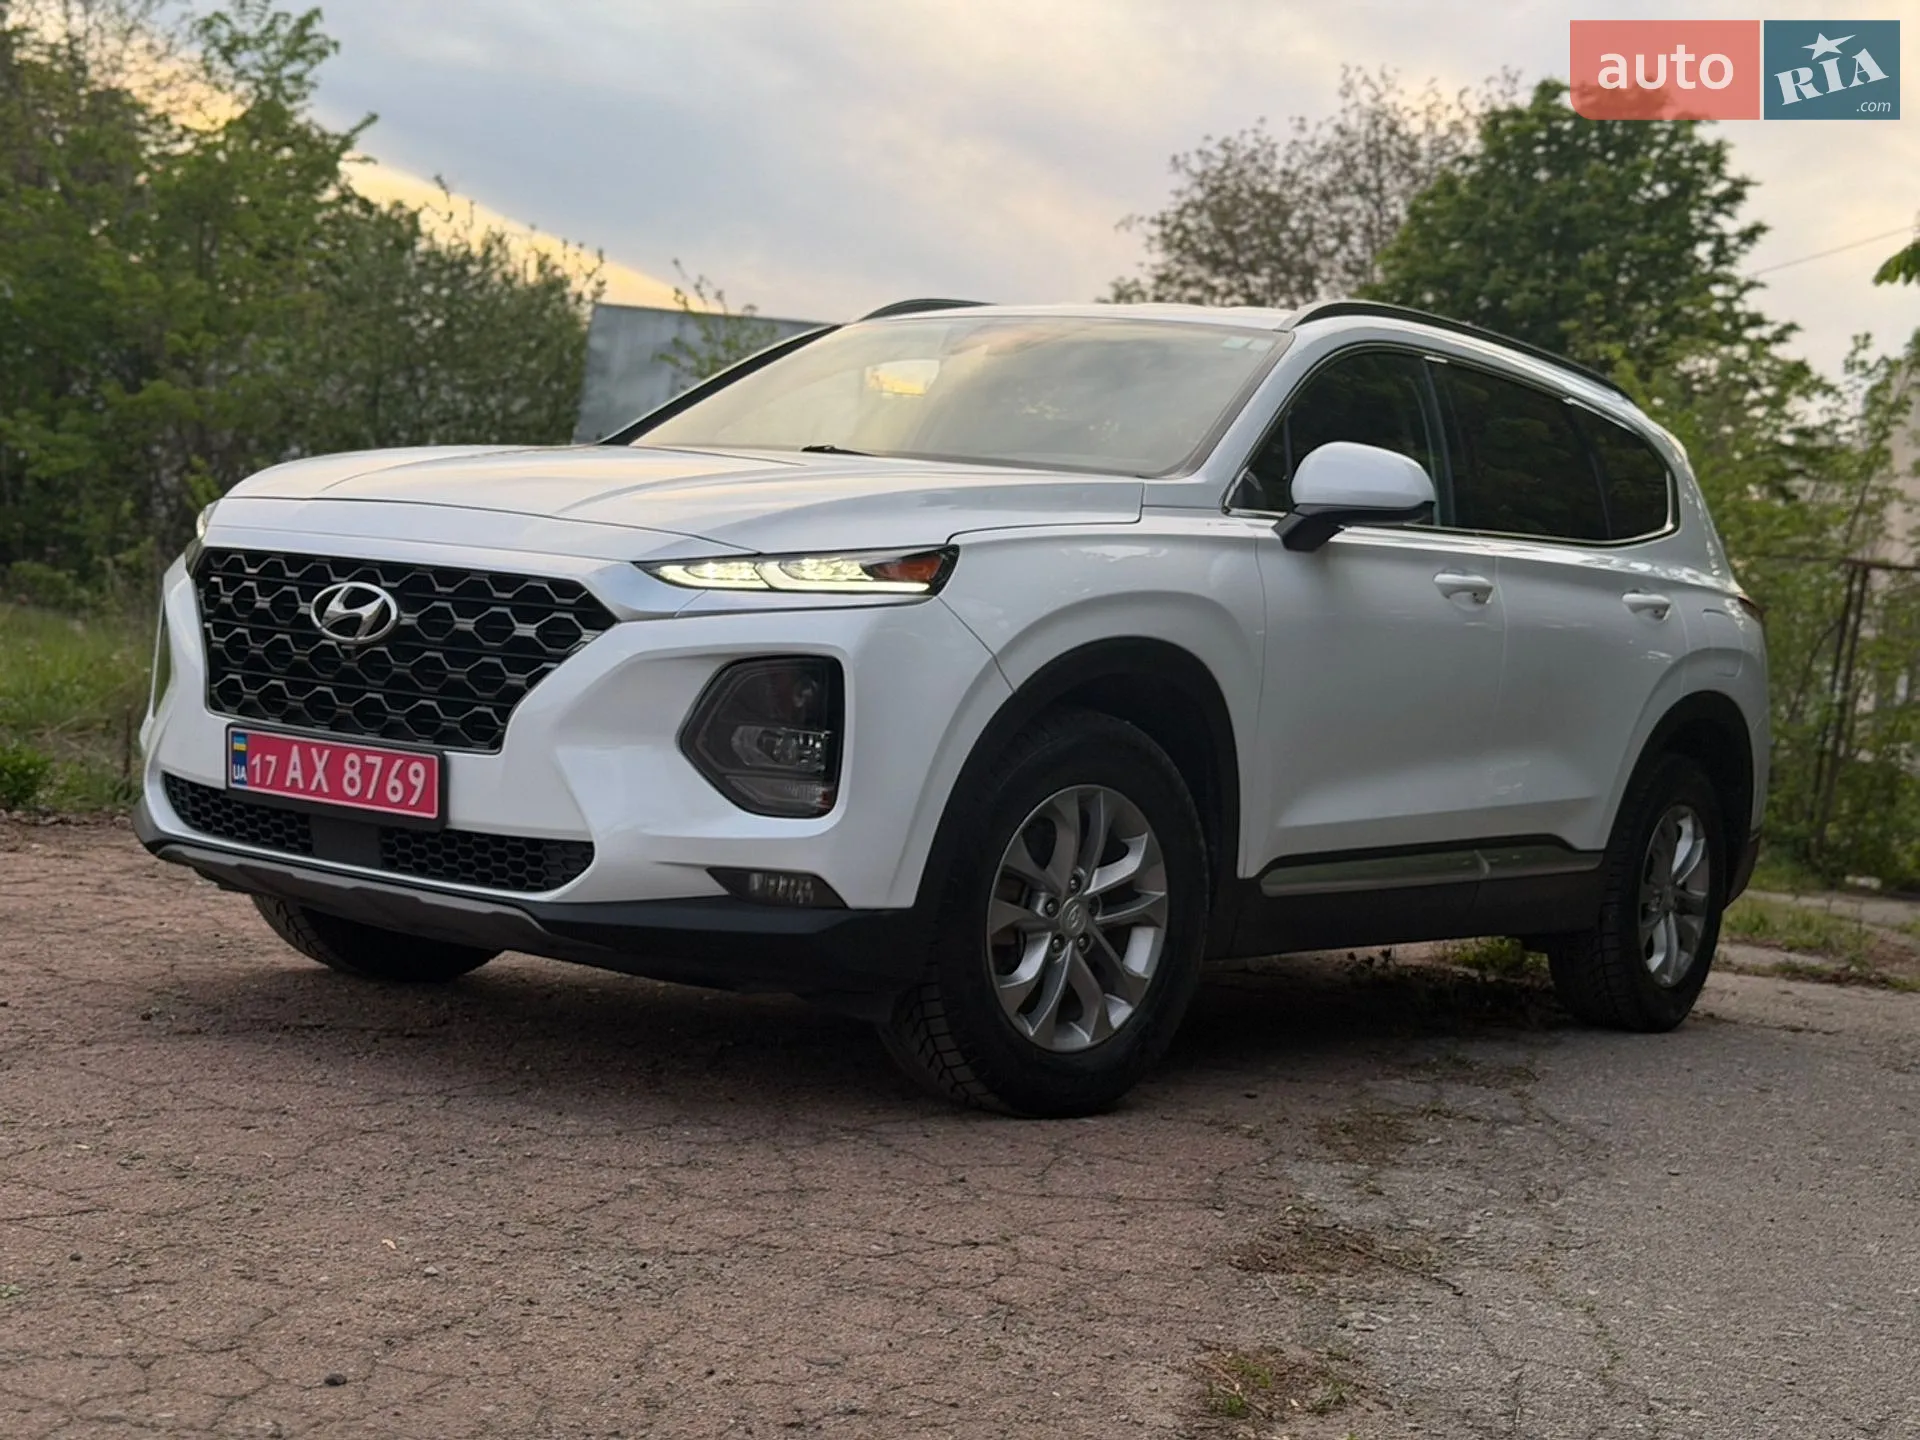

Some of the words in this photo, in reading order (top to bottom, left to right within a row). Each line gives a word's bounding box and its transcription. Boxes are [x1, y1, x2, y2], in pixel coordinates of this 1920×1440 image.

[232, 764, 248, 781] UA
[251, 753, 277, 786] 17
[284, 744, 330, 793] AX
[342, 752, 426, 807] 8769
